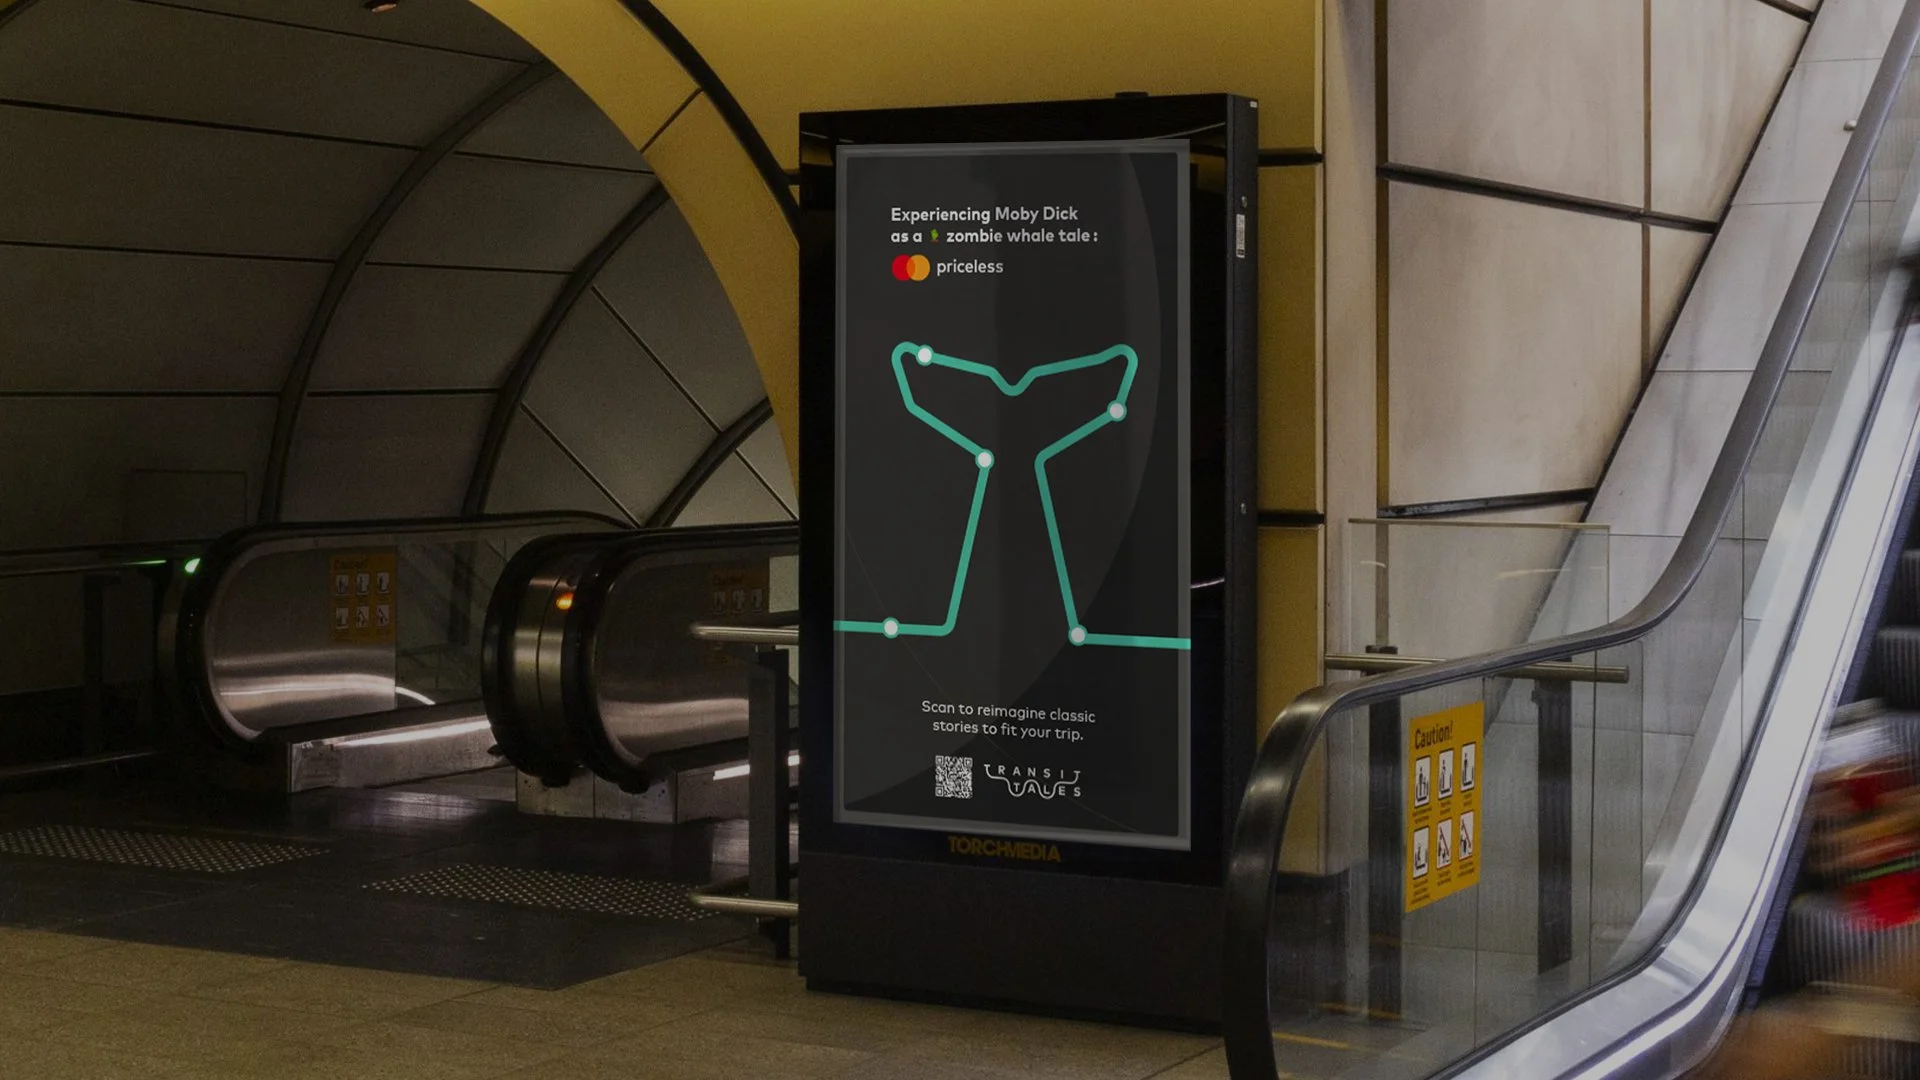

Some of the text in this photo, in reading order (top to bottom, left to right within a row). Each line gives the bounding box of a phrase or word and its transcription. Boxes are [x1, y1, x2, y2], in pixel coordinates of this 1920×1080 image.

[891, 206, 1078, 224] Experiencing Moby Dick
[891, 231, 909, 243] as
[912, 231, 923, 243] a
[946, 228, 1003, 243] zombie
[1007, 228, 1055, 243] whale
[936, 259, 1004, 276] priceless
[921, 700, 1096, 723] Scan to reimagine classic
[932, 720, 1084, 743] stories to fit your trip.
[1414, 722, 1453, 750] Caution!
[983, 763, 1081, 780] TRANSIT
[1012, 781, 1081, 798] TALES
[947, 836, 1061, 862] TORCHMEDIA
